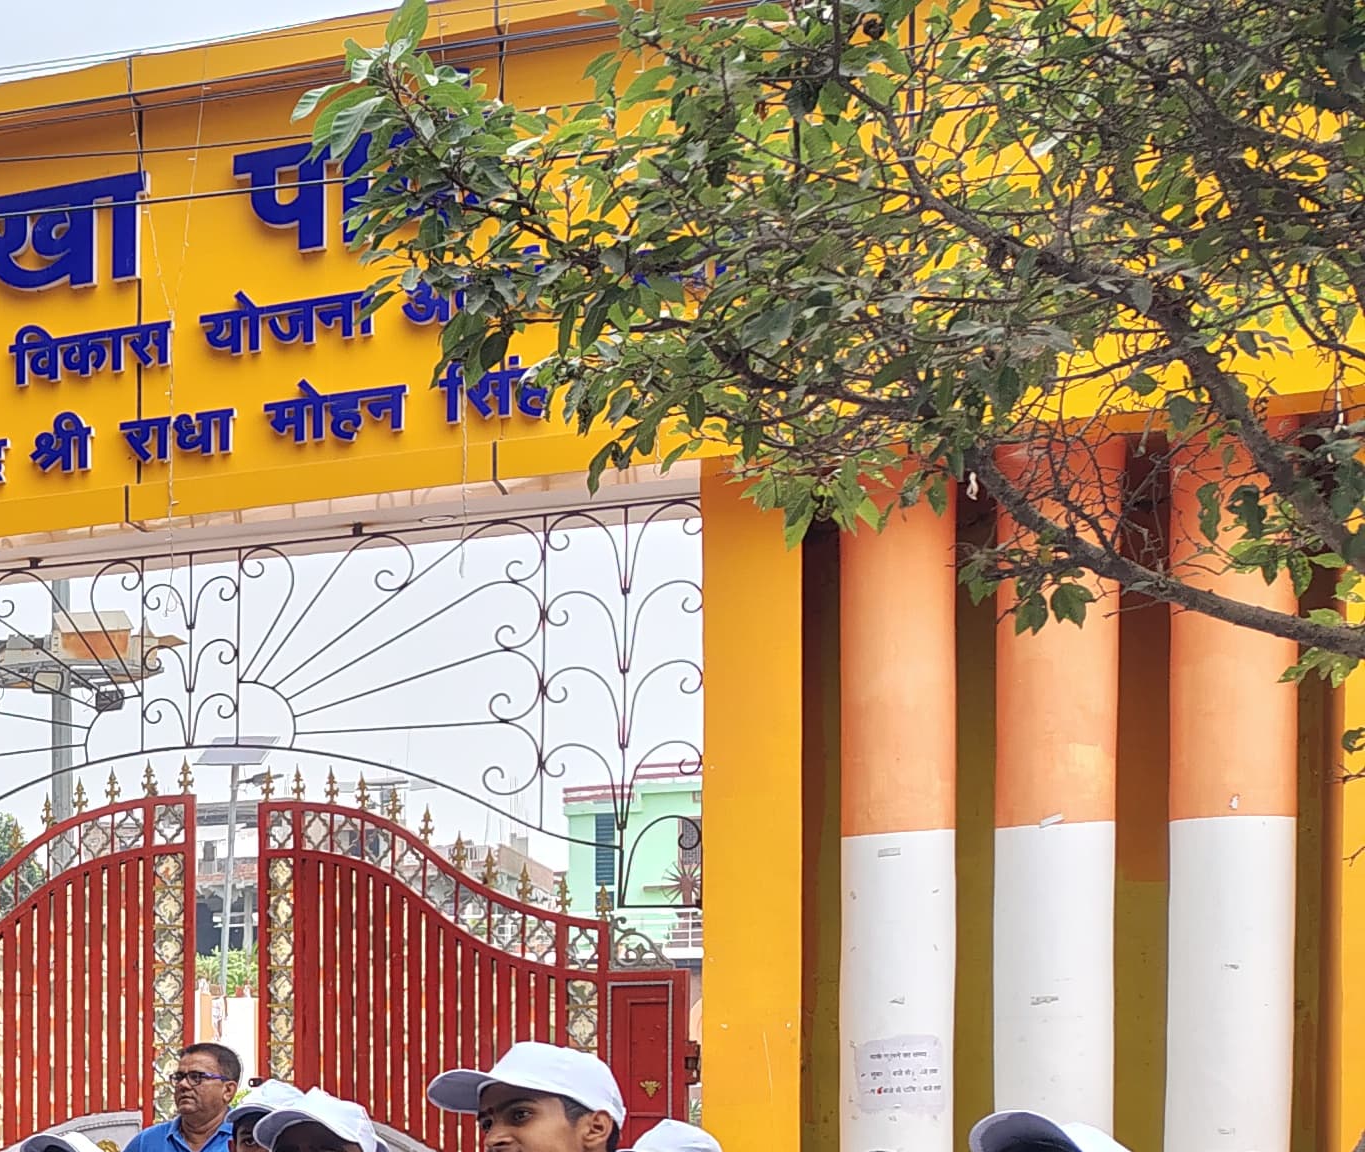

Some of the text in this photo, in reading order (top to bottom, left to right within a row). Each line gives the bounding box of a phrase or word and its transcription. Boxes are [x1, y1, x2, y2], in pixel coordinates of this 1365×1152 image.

[9, 325, 174, 386] विकास
[200, 290, 377, 355] योजना
[29, 412, 94, 472] श्री
[119, 408, 236, 463] राधा
[264, 378, 409, 445] मोहन
